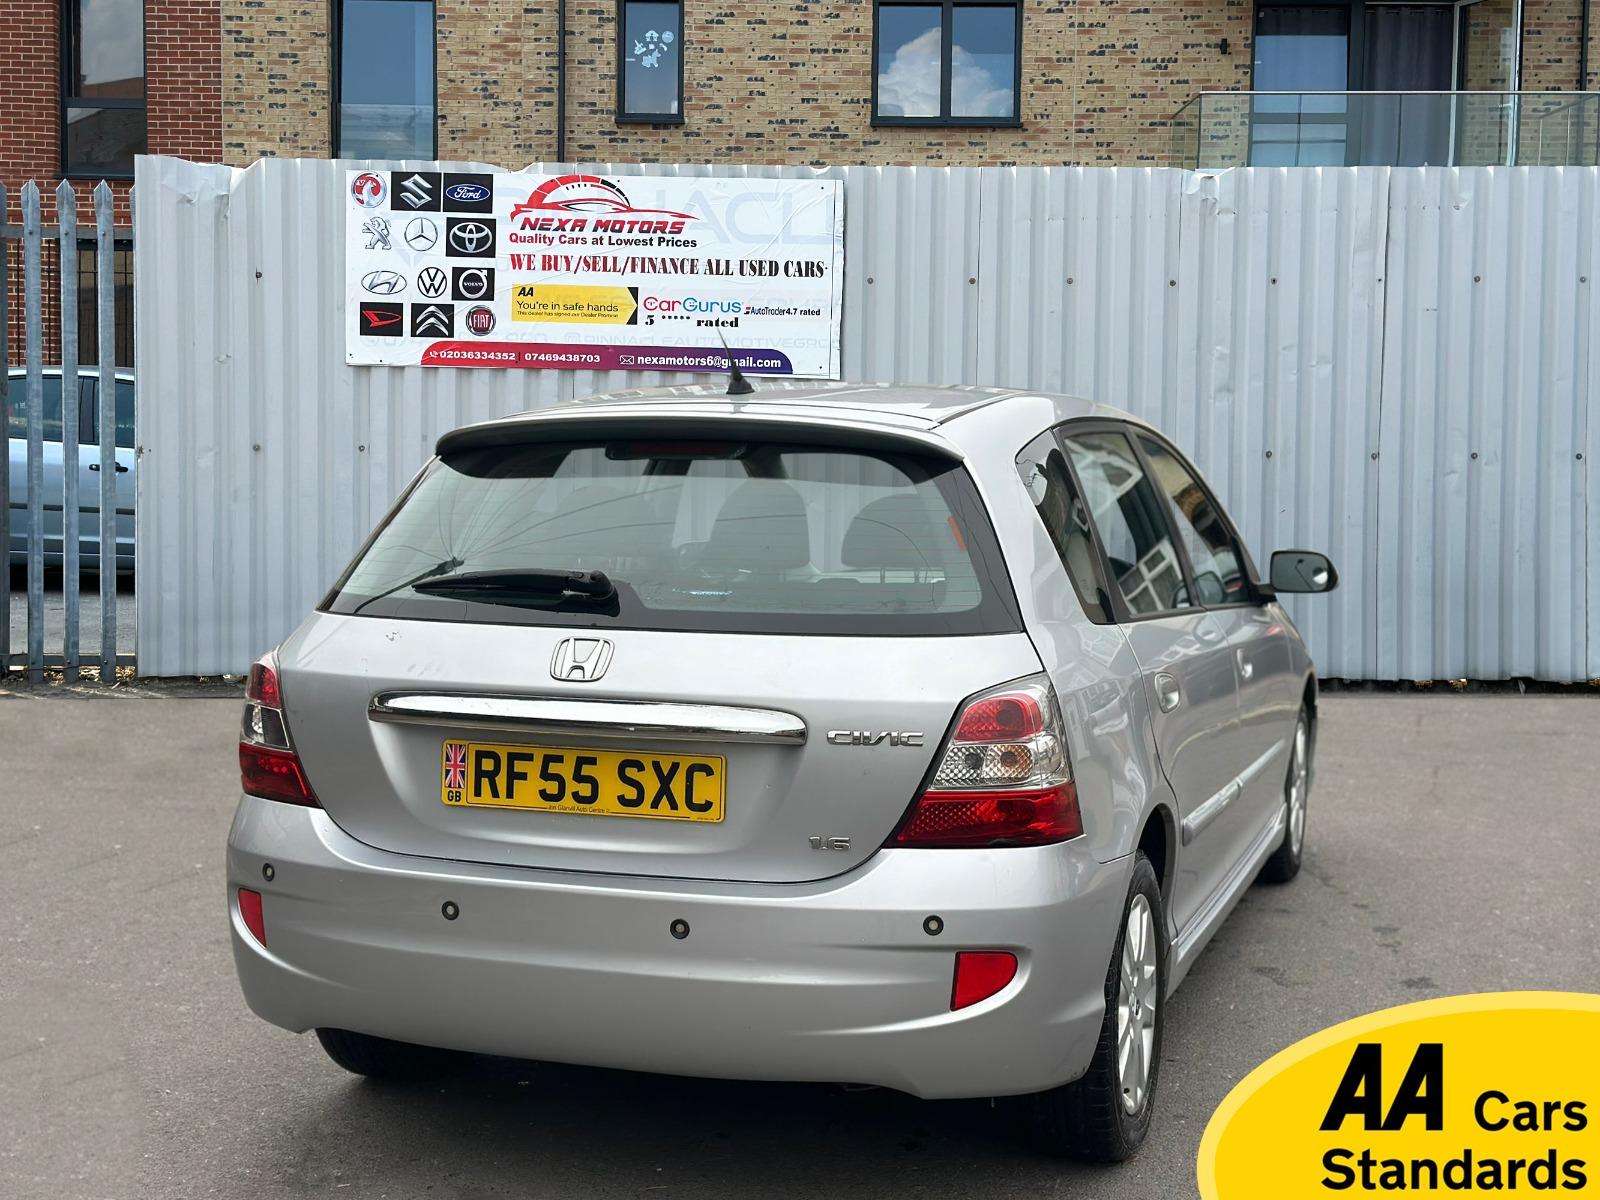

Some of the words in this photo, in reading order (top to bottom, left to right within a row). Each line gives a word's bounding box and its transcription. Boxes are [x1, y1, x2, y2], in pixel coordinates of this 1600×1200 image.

[454, 187, 481, 200] Ford
[520, 217, 588, 232] NEXA
[592, 219, 685, 234] MOTORS
[509, 233, 555, 246] Quality
[559, 234, 587, 245] Cars
[591, 236, 604, 246] at
[608, 235, 653, 246] Lowest
[657, 236, 697, 247] Prices
[509, 254, 536, 271] WE
[541, 255, 699, 275] BUY/SELL/FINANCE
[704, 258, 734, 276] ALL
[740, 259, 779, 277] USED
[783, 260, 825, 278] CARS
[517, 287, 534, 297] AA
[516, 300, 549, 310] You're
[551, 301, 560, 310] in
[562, 302, 584, 311] safe
[587, 302, 619, 312] hands
[643, 296, 742, 313] CarGurus
[800, 308, 820, 316] rated
[473, 314, 489, 328] FIAT
[645, 314, 655, 325] 5
[696, 317, 739, 328] rated
[439, 351, 516, 360] 02036334352
[524, 353, 601, 363] 07469438703
[827, 730, 924, 747] CIVIC
[473, 750, 599, 805] RF55
[616, 758, 715, 813] SXC
[447, 790, 462, 803] GB
[809, 836, 851, 850] 1.6
